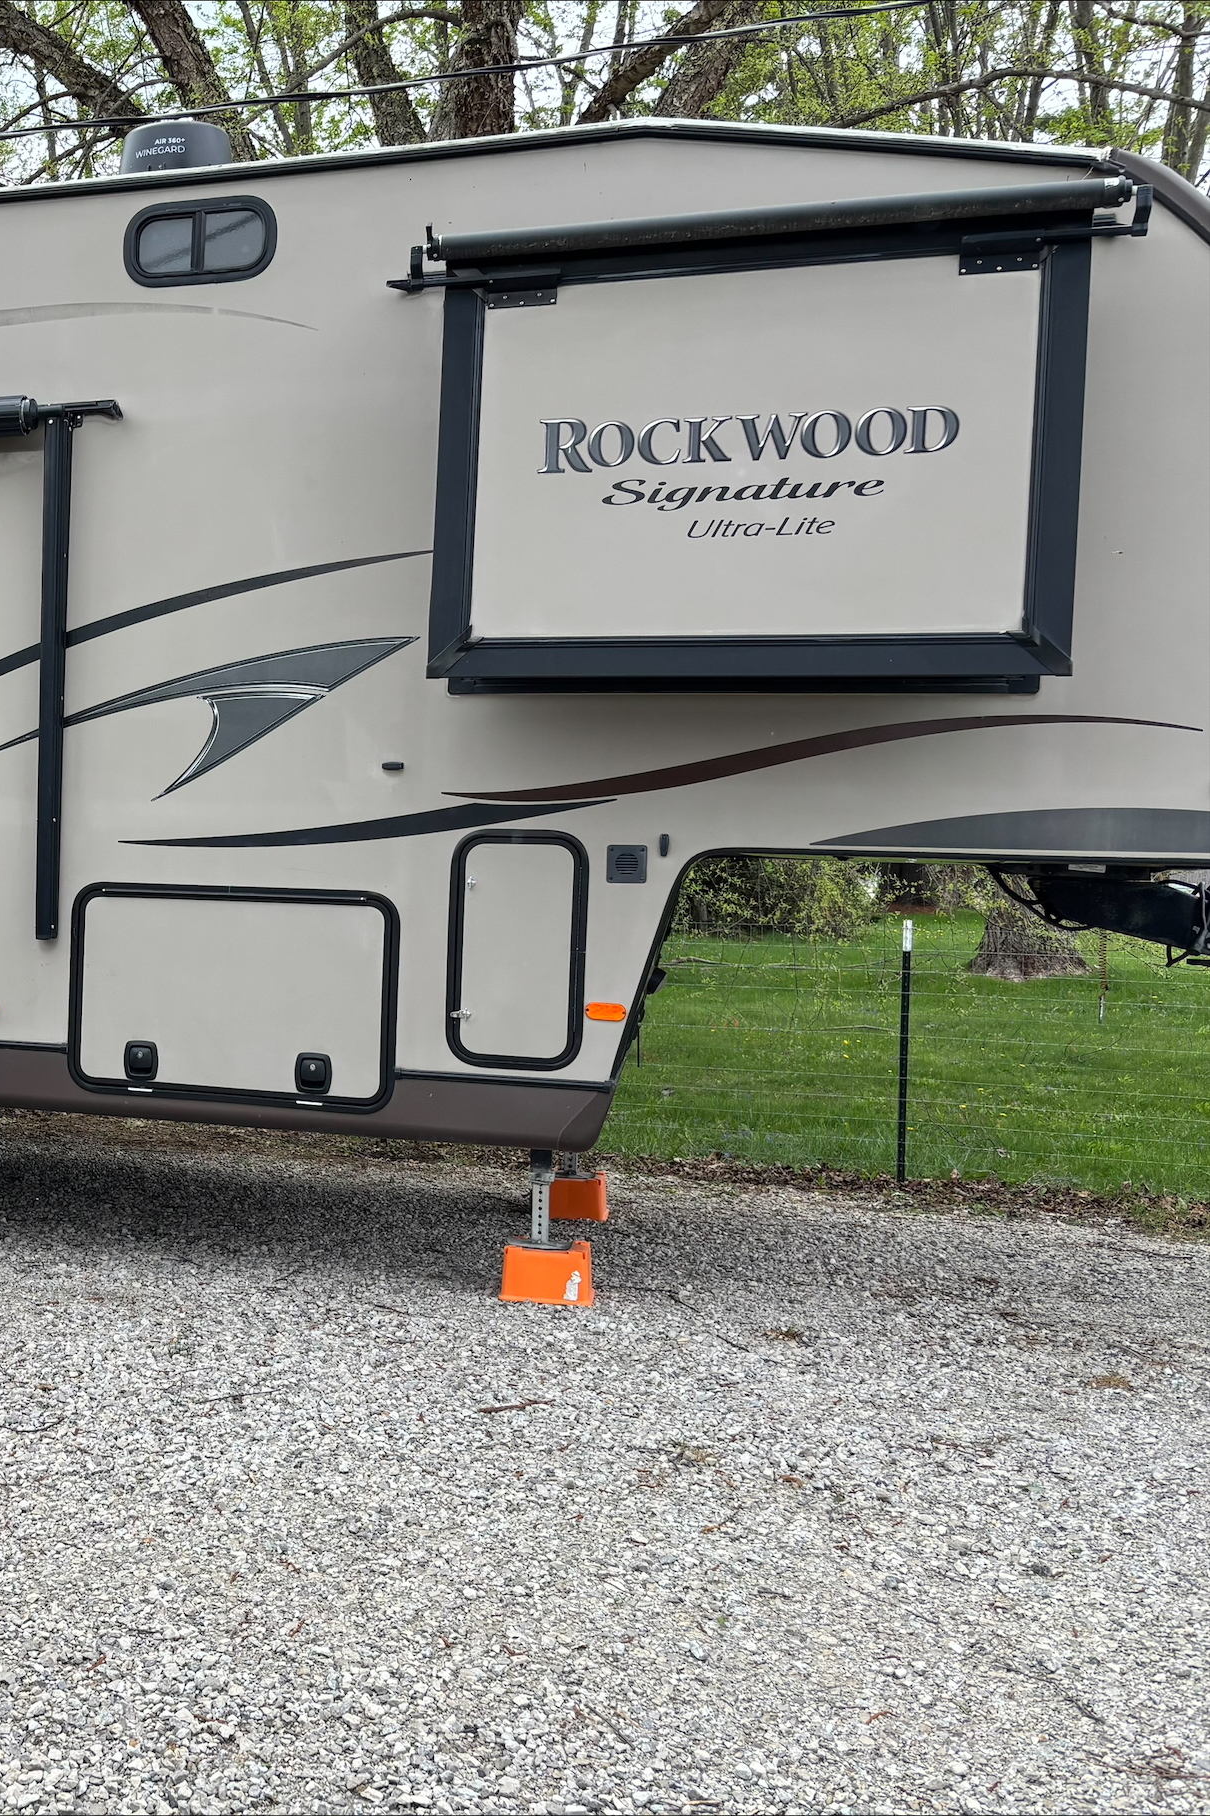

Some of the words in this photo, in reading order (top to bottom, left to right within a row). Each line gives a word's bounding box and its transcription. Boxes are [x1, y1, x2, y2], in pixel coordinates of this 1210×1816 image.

[136, 146, 185, 158] WINEGARD
[537, 404, 960, 475] ROCKWOOD
[601, 475, 885, 512] Signature
[687, 516, 836, 540] Ultra-Lite
